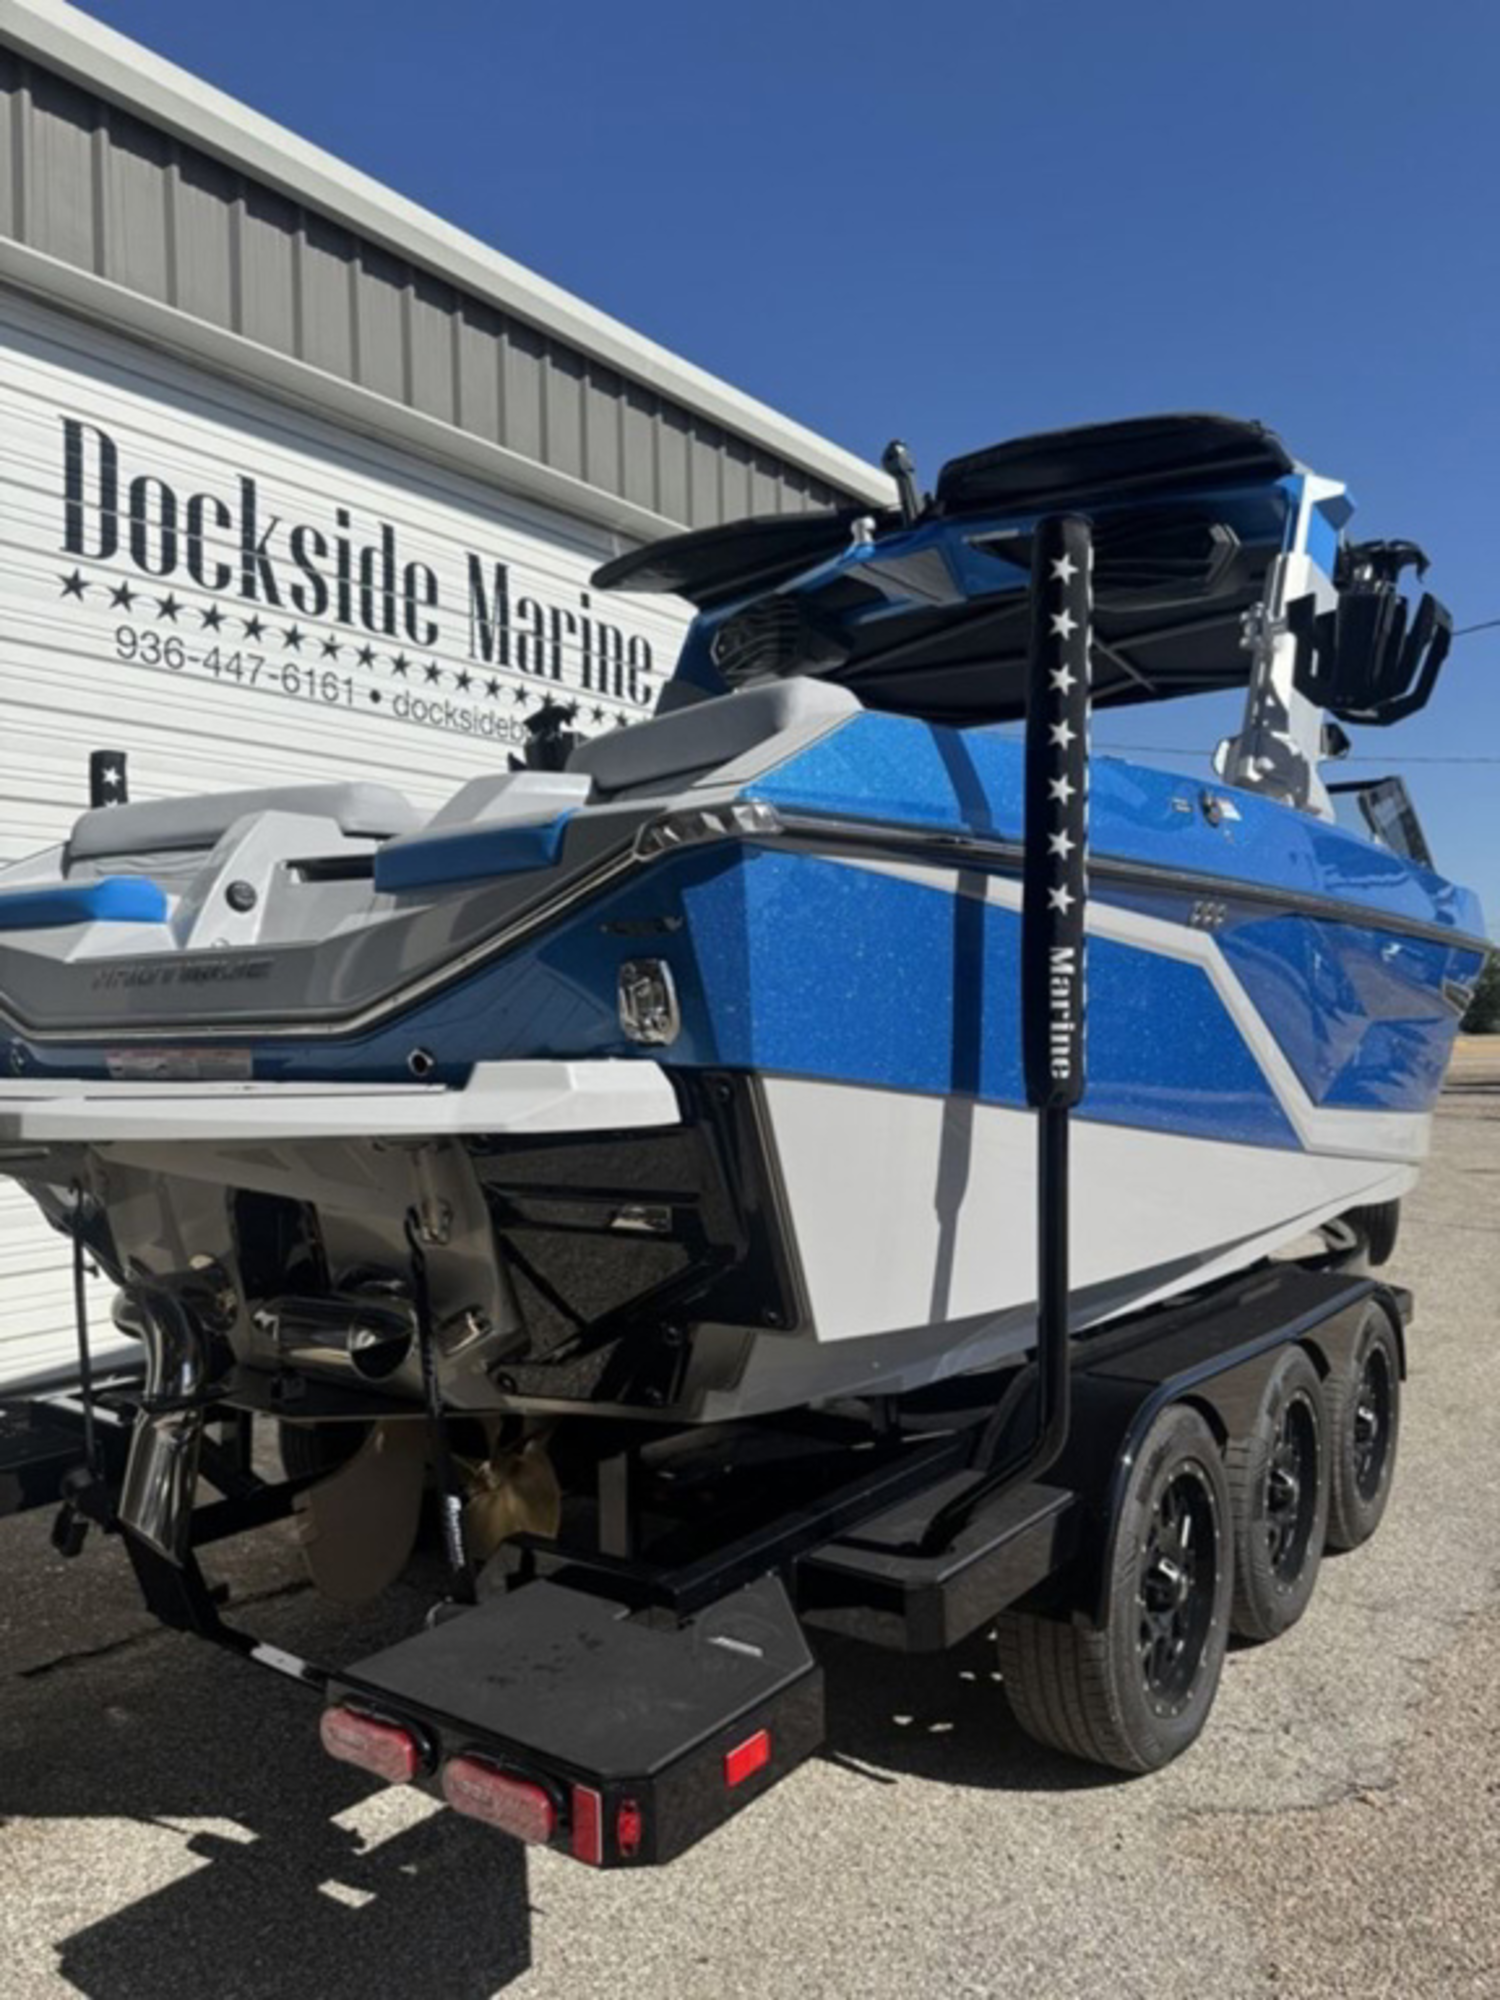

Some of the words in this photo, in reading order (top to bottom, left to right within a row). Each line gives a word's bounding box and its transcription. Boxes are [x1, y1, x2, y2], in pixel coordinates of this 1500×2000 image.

[58, 414, 439, 647] Dockside
[466, 551, 652, 706] Marine
[115, 625, 353, 705] 936-447-6161
[392, 689, 530, 742] docksideb
[1049, 947, 1076, 1079] Marine
